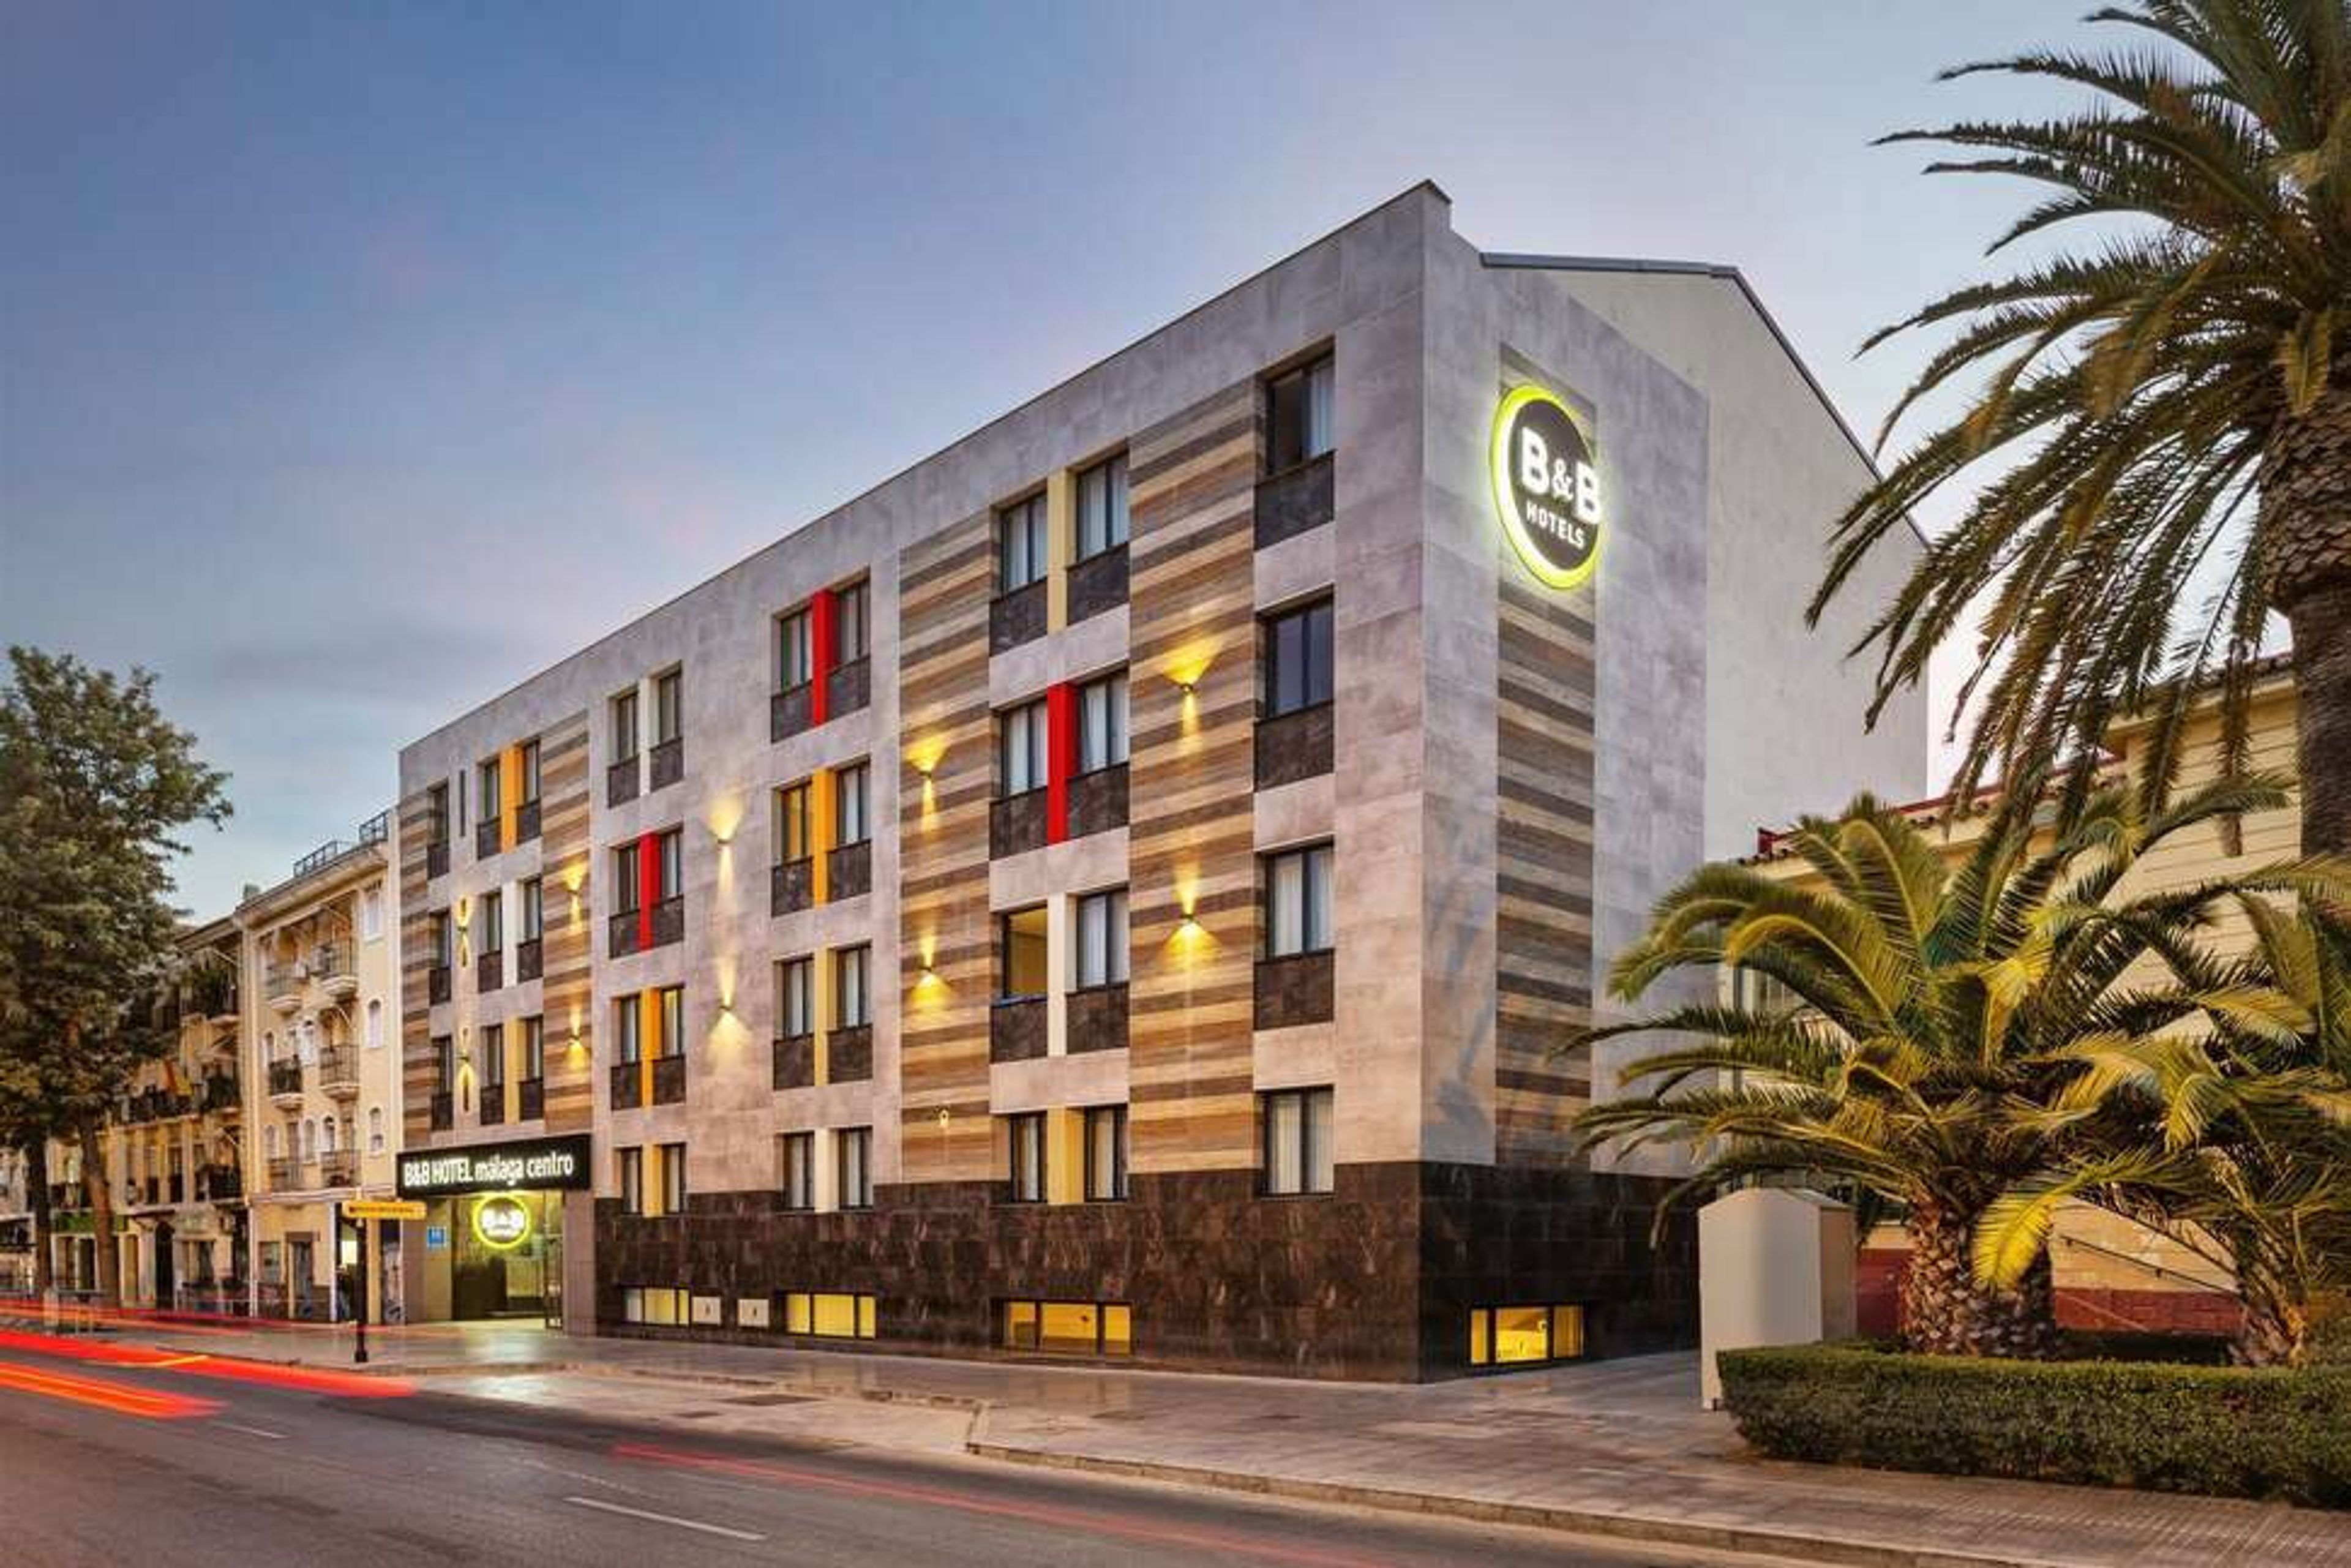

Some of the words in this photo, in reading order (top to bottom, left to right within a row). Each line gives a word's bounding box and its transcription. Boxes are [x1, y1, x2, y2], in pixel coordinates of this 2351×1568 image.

[1521, 427, 1601, 525] B&B
[1526, 499, 1585, 550] HOTELS
[404, 1161, 429, 1187] B&B
[431, 1157, 473, 1184] HOTEL
[526, 1150, 574, 1179] centro
